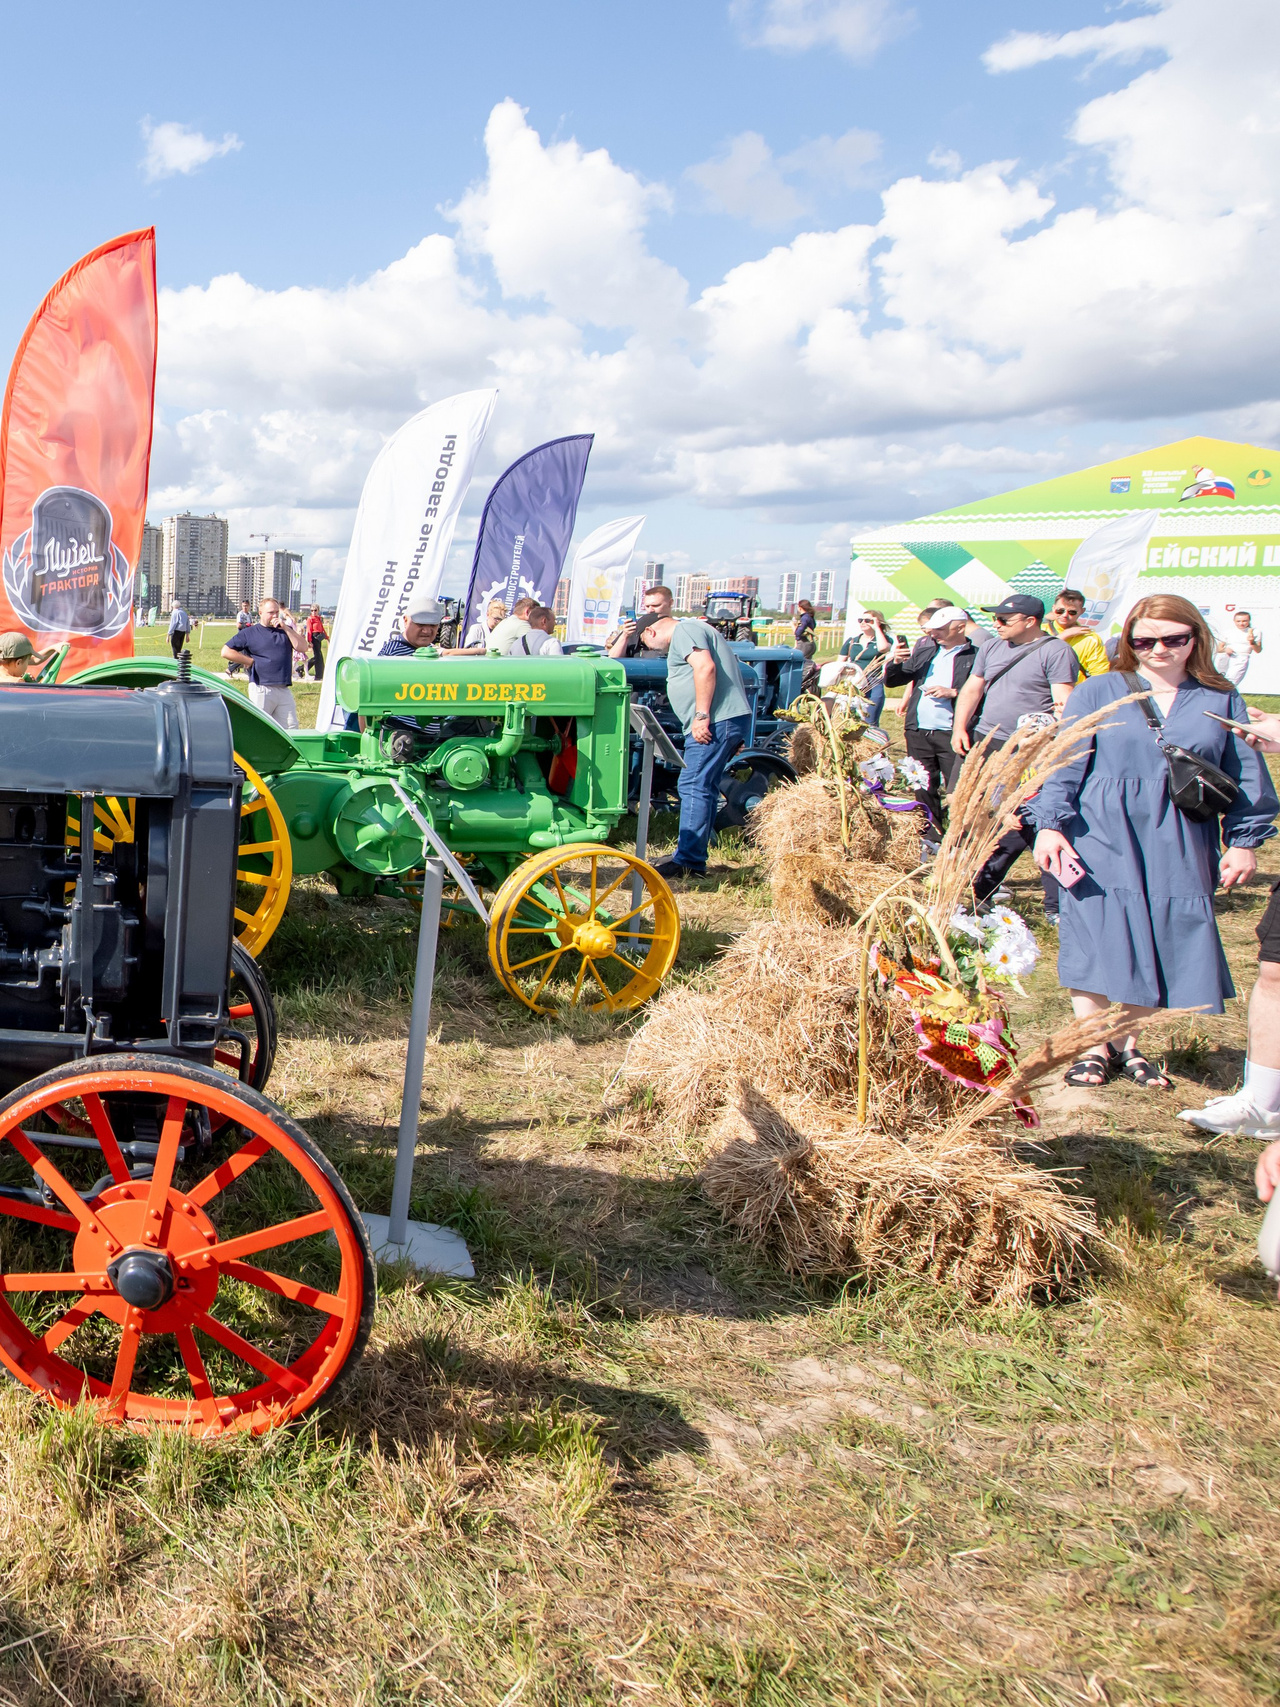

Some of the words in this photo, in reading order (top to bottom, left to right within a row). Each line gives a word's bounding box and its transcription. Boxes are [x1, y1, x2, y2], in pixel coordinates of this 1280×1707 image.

[35, 533, 105, 578] Музей
[388, 523, 433, 642] ракторные
[424, 434, 457, 518] заводы
[1141, 541, 1257, 571] ЕЙСКИЙ
[39, 575, 99, 597] ТРАКТОРА
[505, 535, 526, 618] АШИНОСТРОИТЕЛЕЙ
[358, 560, 398, 652] Концерн
[394, 683, 459, 701] JOHN
[466, 683, 546, 701] DEERE
